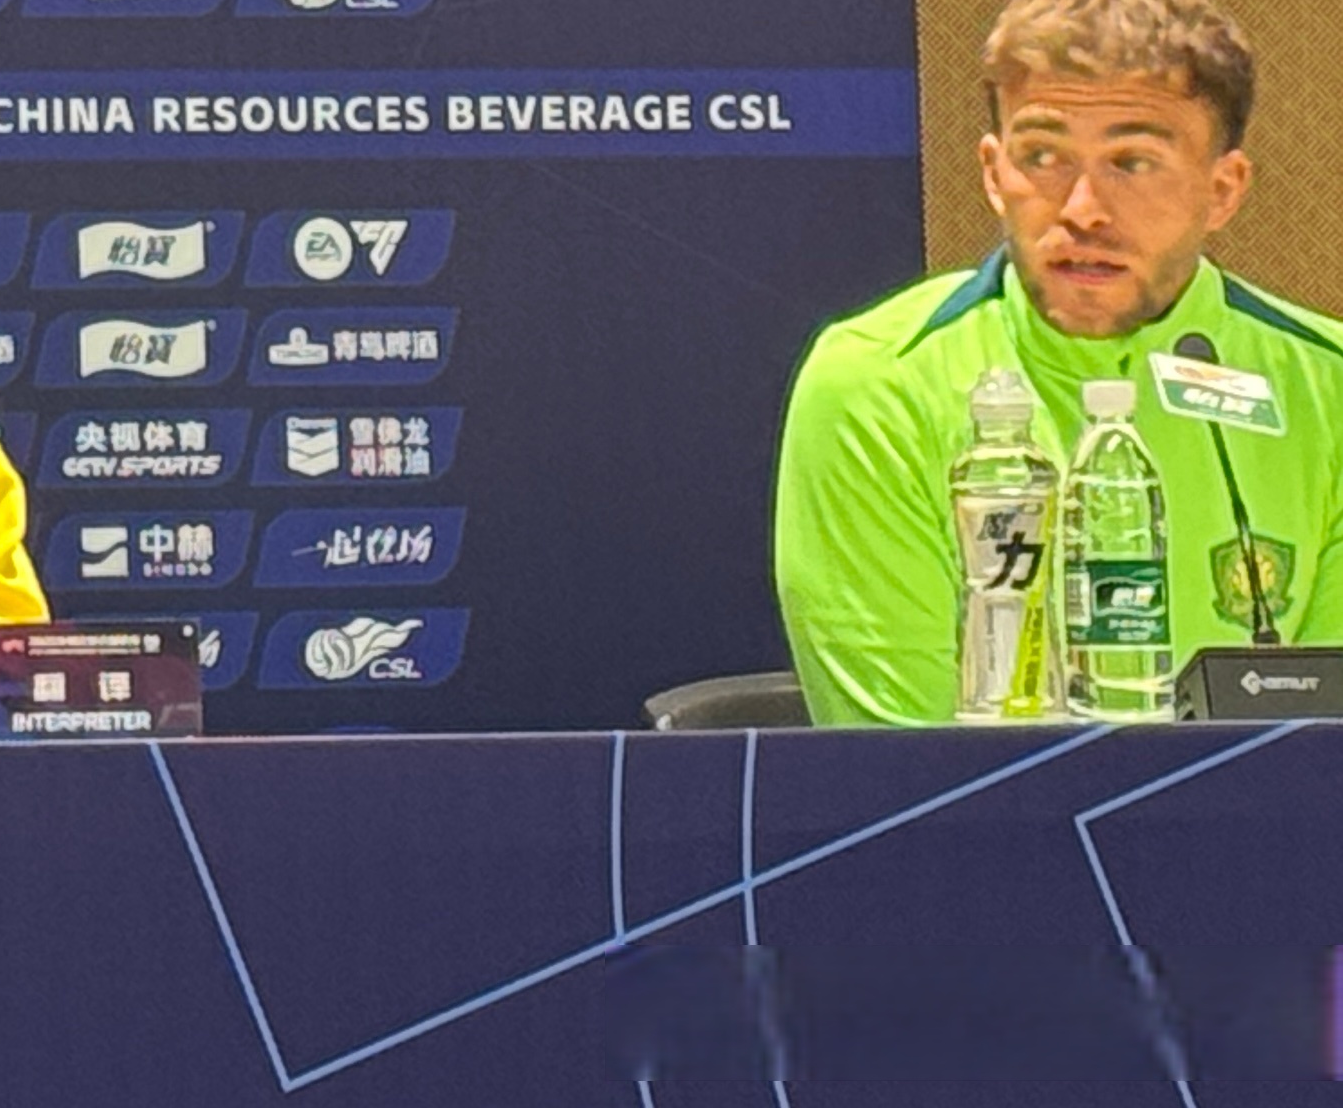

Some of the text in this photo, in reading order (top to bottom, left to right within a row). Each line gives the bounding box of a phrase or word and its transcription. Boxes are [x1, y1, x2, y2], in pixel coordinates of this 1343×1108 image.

[154, 97, 428, 132] RESOURCES
[449, 96, 690, 130] BEVERAGE
[710, 95, 790, 129] CSL
[76, 421, 207, 452] 央视体育
[370, 657, 421, 678] CSL
